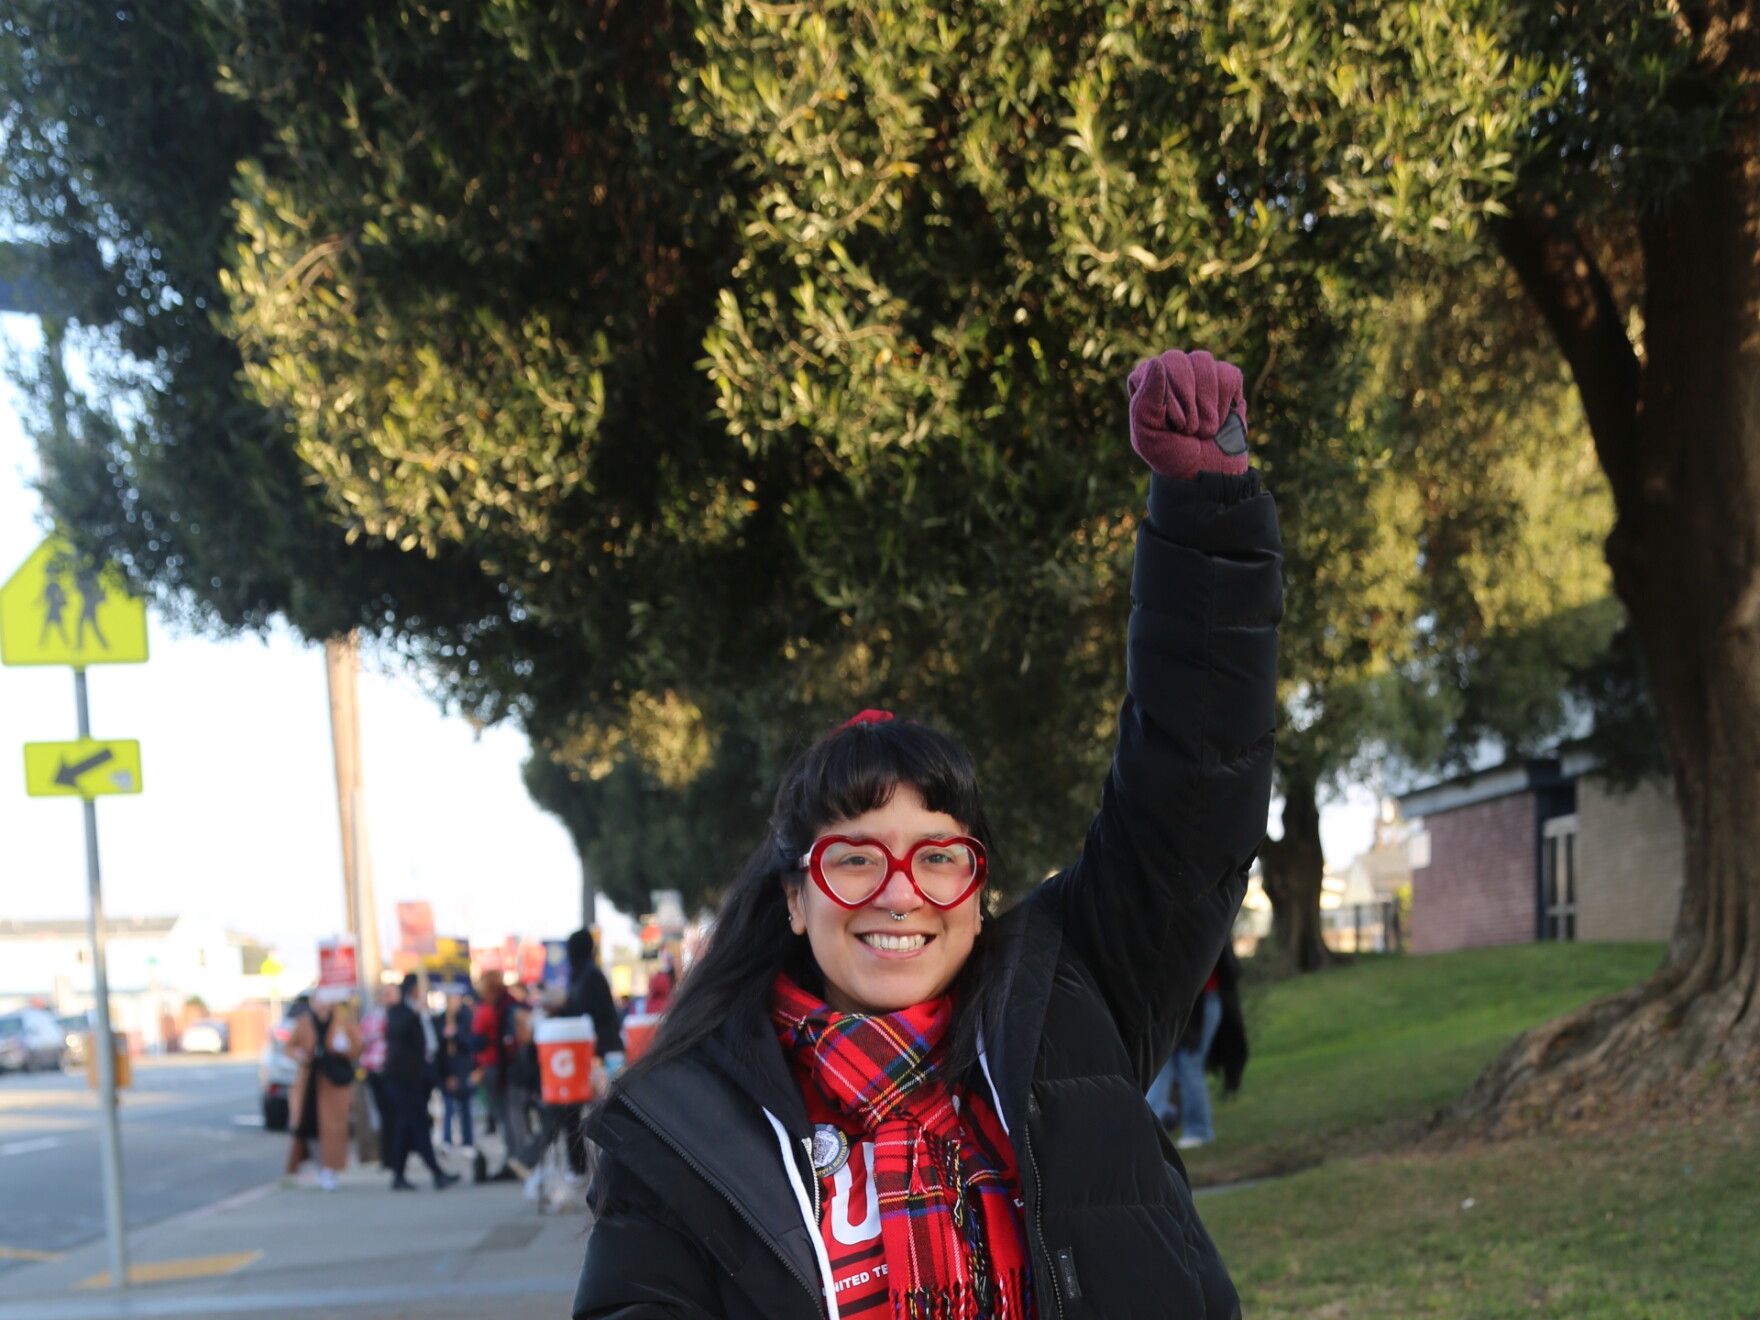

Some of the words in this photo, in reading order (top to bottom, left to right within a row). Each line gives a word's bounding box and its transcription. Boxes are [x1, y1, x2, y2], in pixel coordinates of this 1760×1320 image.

[549, 1047, 577, 1078] G
[822, 1271, 870, 1297] ITED
[872, 1263, 889, 1278] TE
